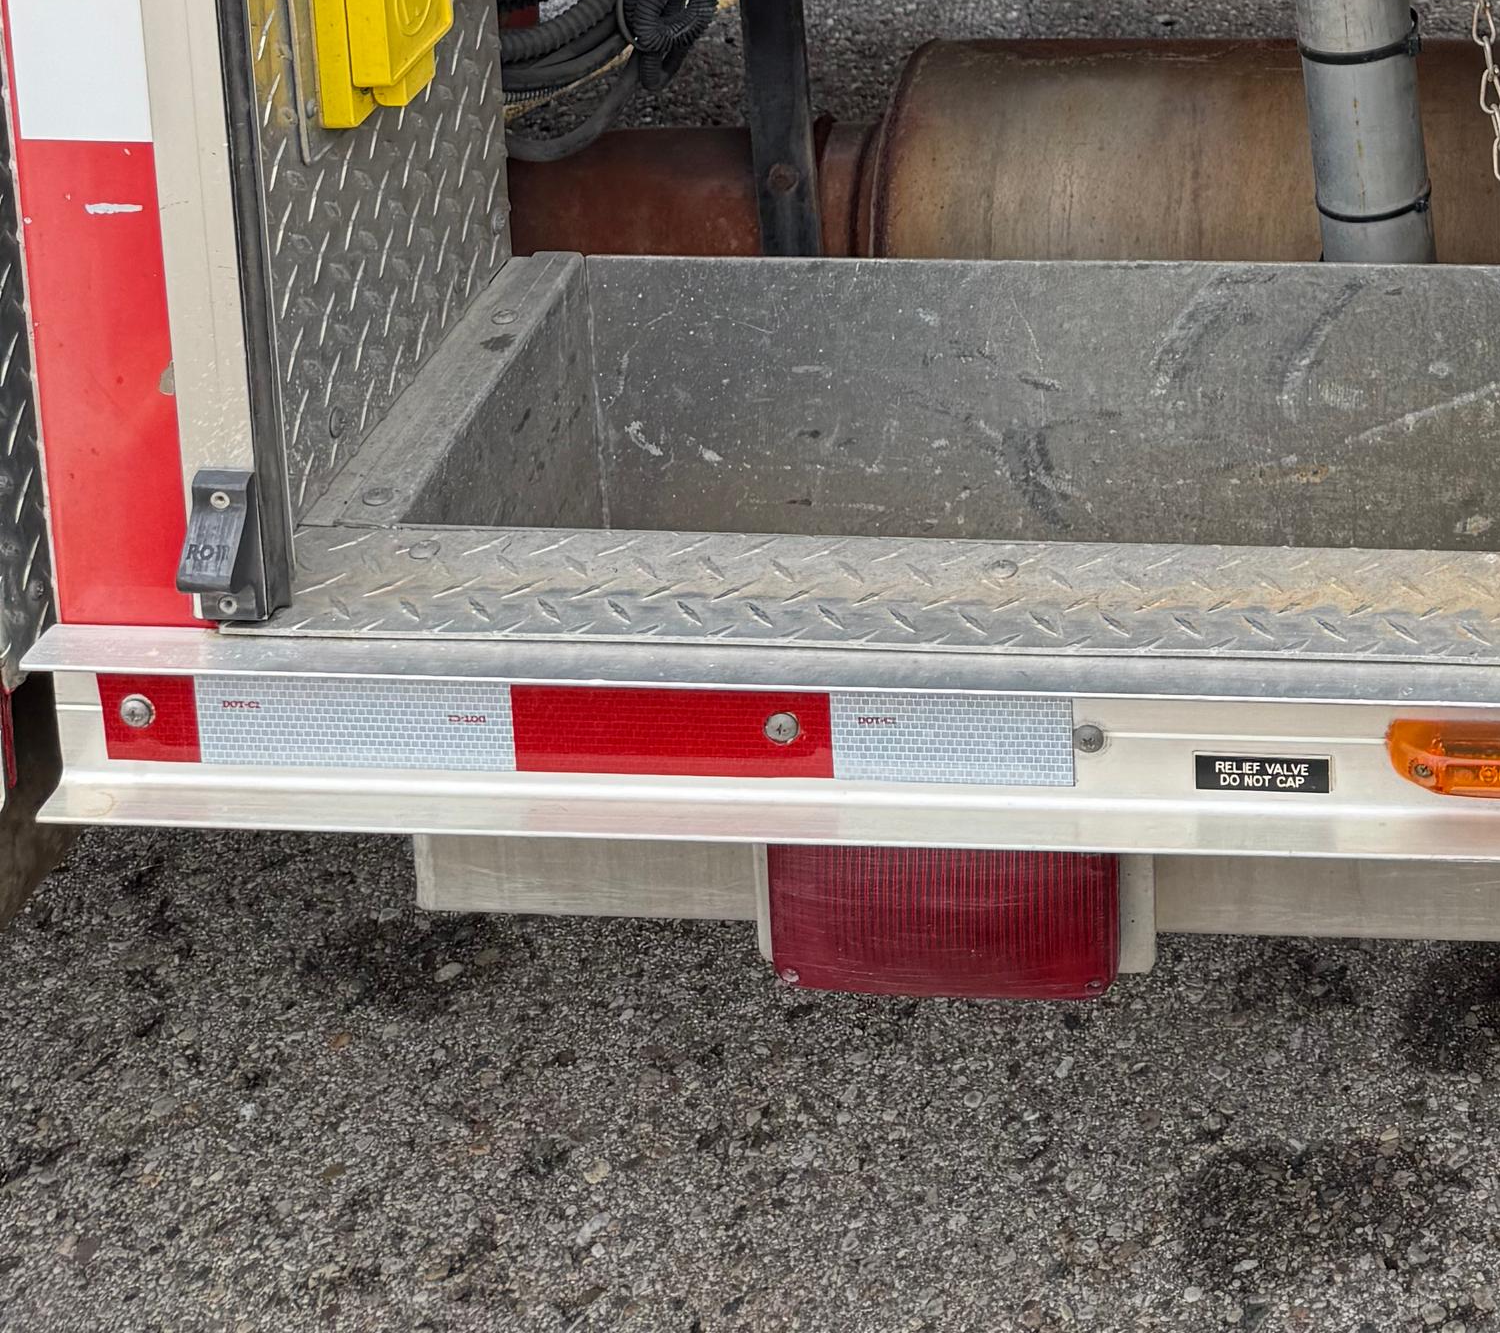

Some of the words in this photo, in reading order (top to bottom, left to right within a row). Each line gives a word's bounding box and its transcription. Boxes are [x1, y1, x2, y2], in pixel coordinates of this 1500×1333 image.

[222, 700, 260, 709] DOT-C2
[858, 716, 896, 725] DOT-C2
[1215, 761, 1260, 774] RELIEF
[1265, 763, 1309, 776] VALVE
[1220, 774, 1240, 786] DO
[1244, 775, 1272, 787] NOT
[1276, 776, 1305, 789] CAP
